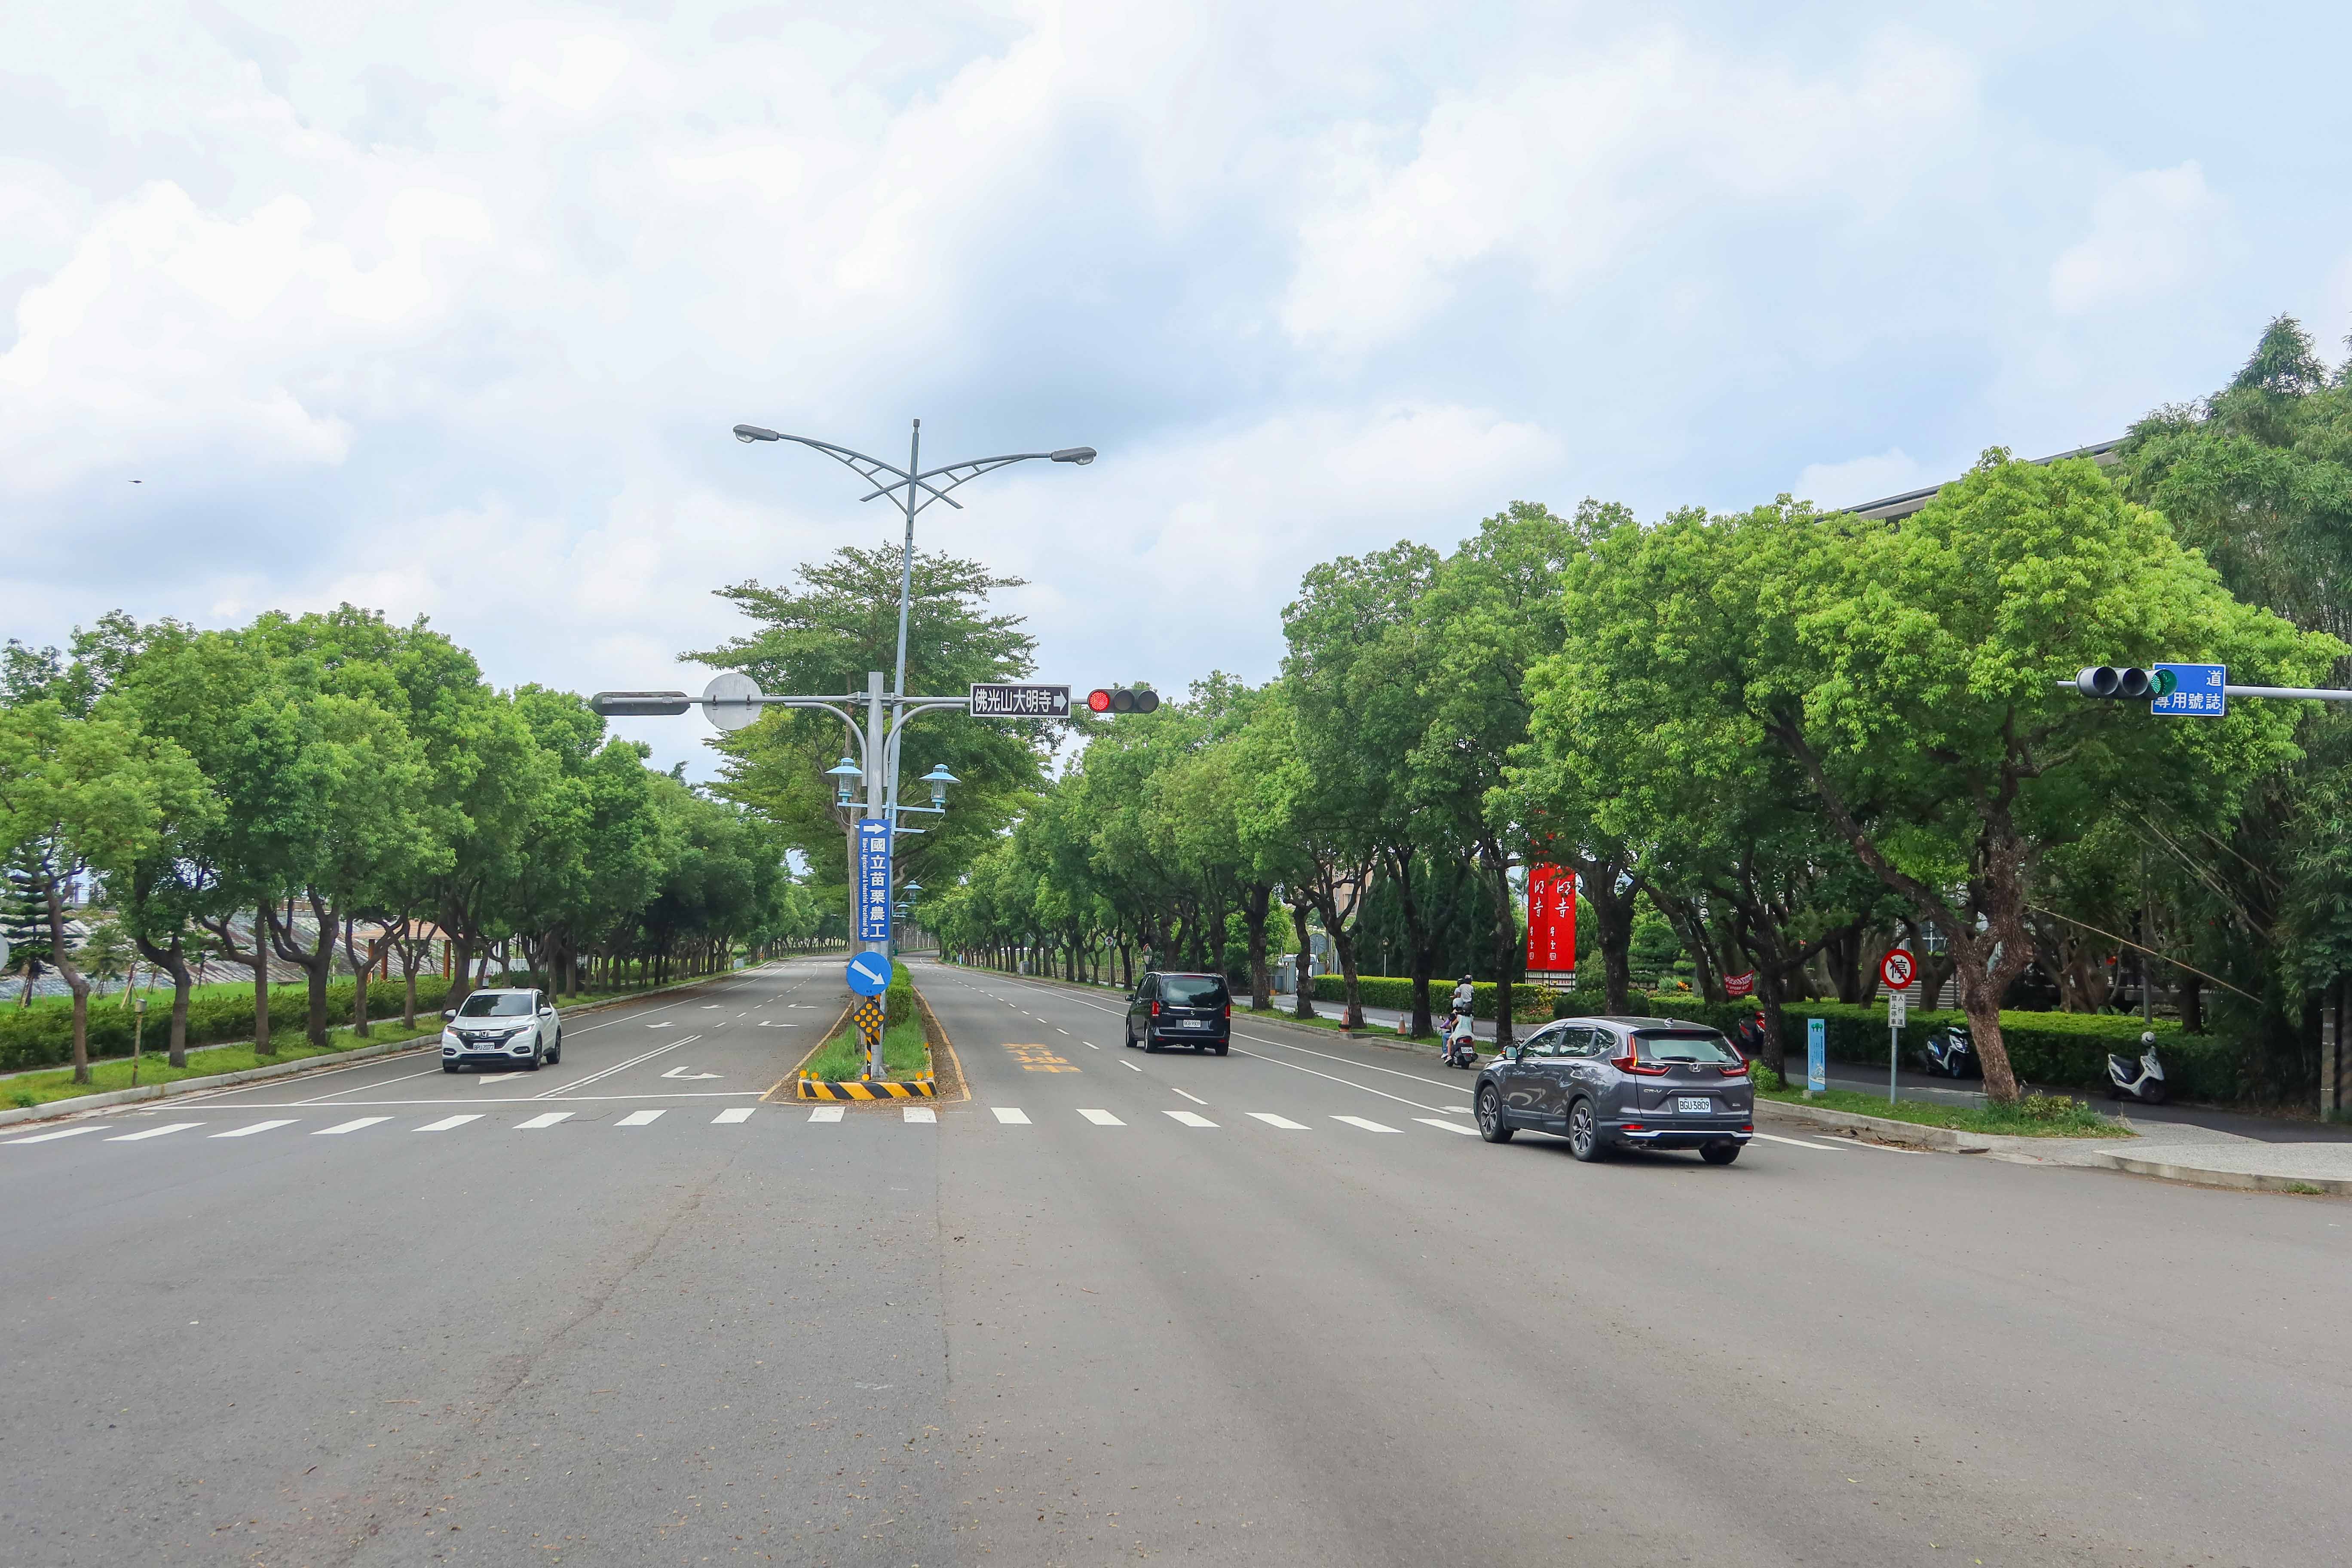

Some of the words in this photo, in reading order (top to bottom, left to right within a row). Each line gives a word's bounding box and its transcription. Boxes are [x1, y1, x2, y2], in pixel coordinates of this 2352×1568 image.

[2206, 670, 2222, 686] 道
[974, 688, 1052, 713] 佛光山大明寺
[2154, 692, 2221, 710] 專用號誌
[870, 838, 886, 937] 國立苗栗農工
[1679, 1100, 1709, 1110] BGU-3809
